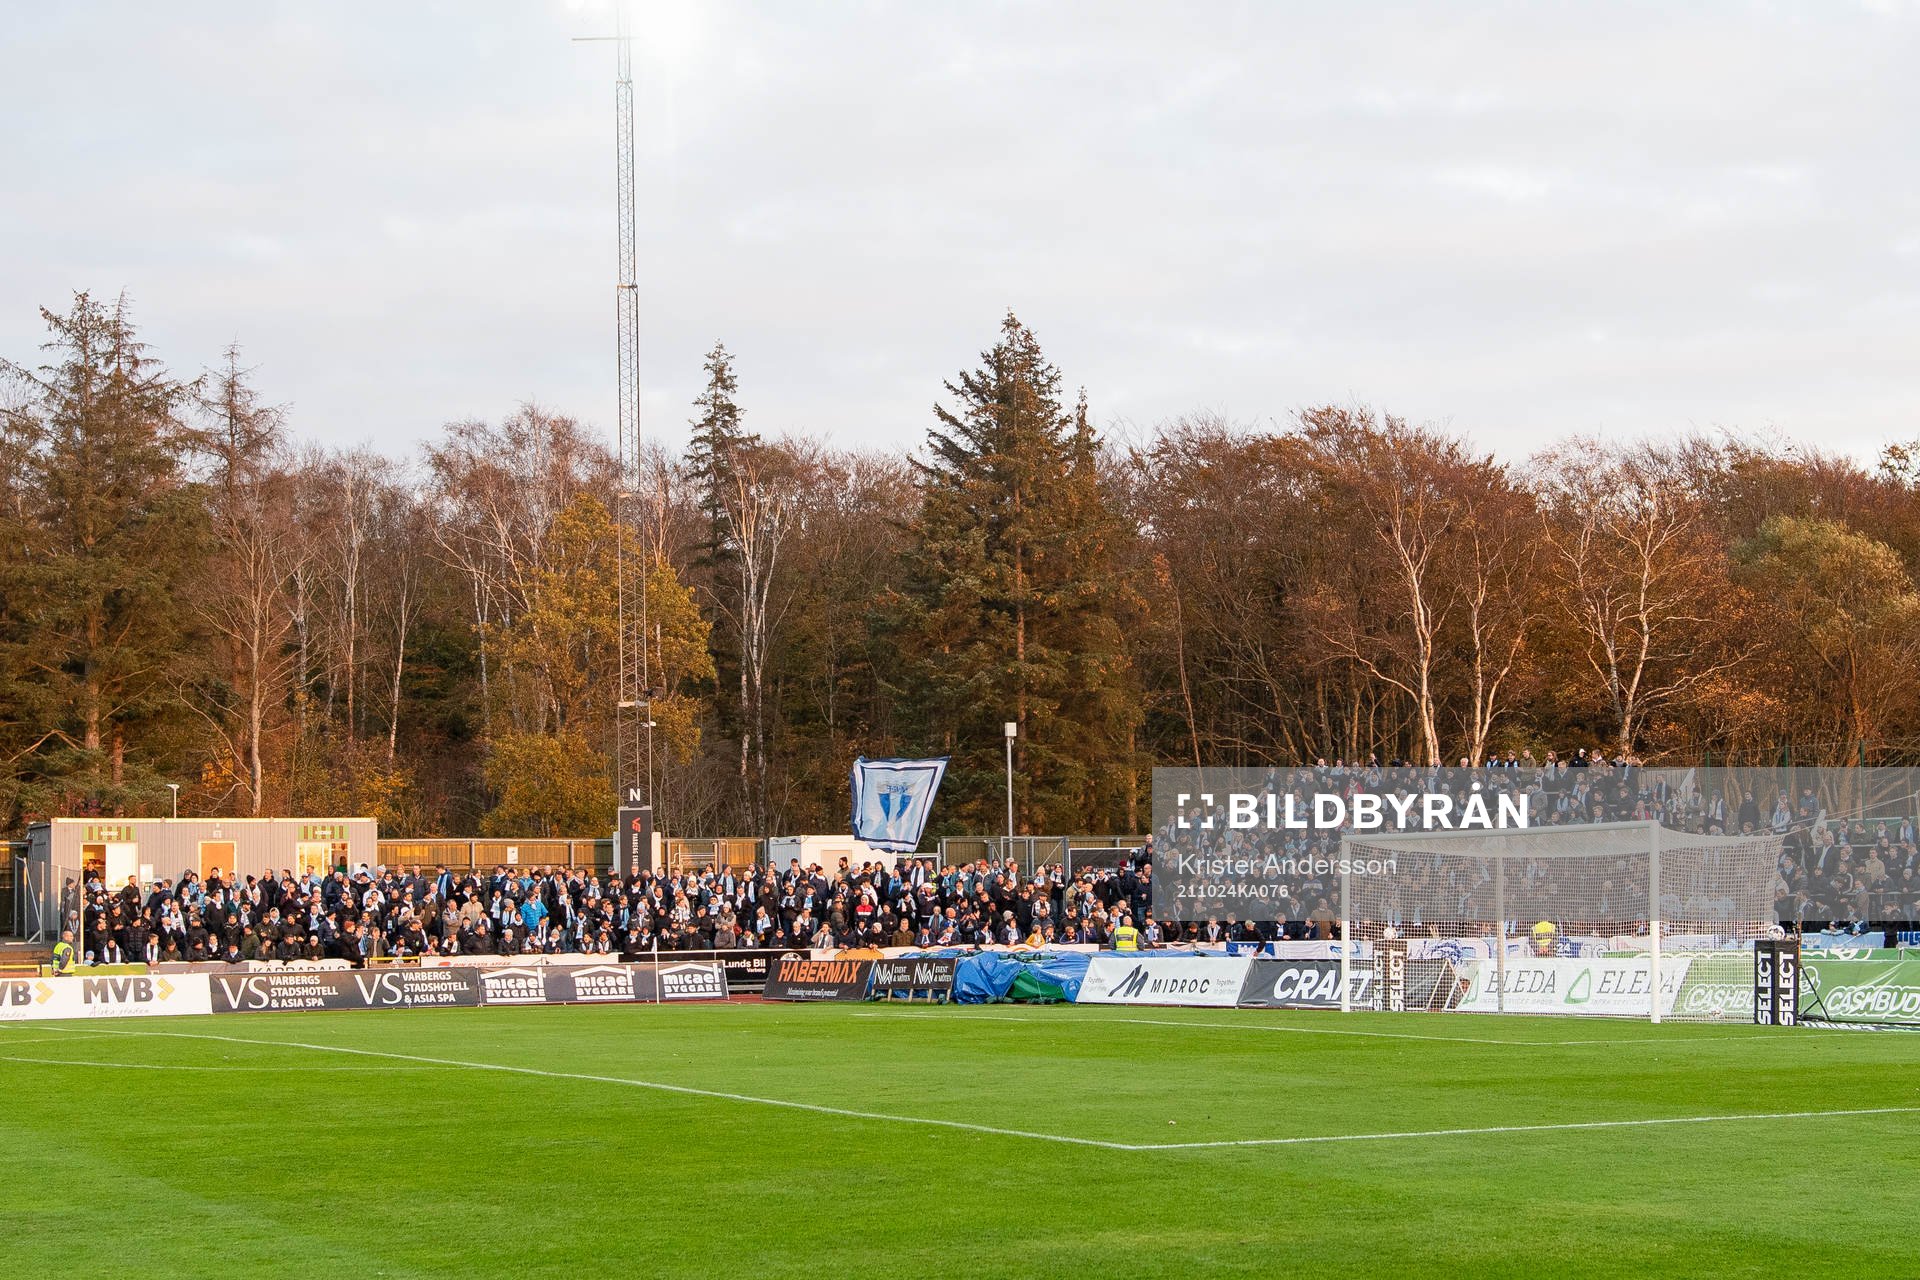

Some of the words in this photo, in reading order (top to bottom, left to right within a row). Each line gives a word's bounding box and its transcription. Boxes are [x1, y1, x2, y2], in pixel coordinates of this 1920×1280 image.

[629, 788, 641, 801] N
[722, 958, 752, 968] Lunds
[753, 958, 766, 968] Bil
[402, 971, 452, 982] VARBERGS
[778, 961, 862, 984] HABERMAX
[269, 975, 321, 986] VARBERGS
[1150, 978, 1210, 994] MIDROC
[1485, 970, 1556, 994] ELEDA
[83, 977, 154, 1005] MVB
[219, 976, 269, 1009] VS
[271, 986, 339, 997] STADSHOTELL
[354, 973, 403, 1005] VS
[403, 982, 470, 993] STADSHOTELL
[575, 986, 635, 996] BYGGARE
[664, 984, 722, 993] BYGGARE
[1757, 951, 1772, 1025] SELECT
[1779, 951, 1795, 1026] SELECT
[404, 995, 412, 1004] &
[413, 994, 439, 1004] ASIA
[440, 993, 456, 1003] SPA
[486, 989, 546, 998] BYGGARE
[271, 999, 279, 1008] &
[281, 998, 306, 1008] ASIA
[307, 997, 325, 1007] SPA
